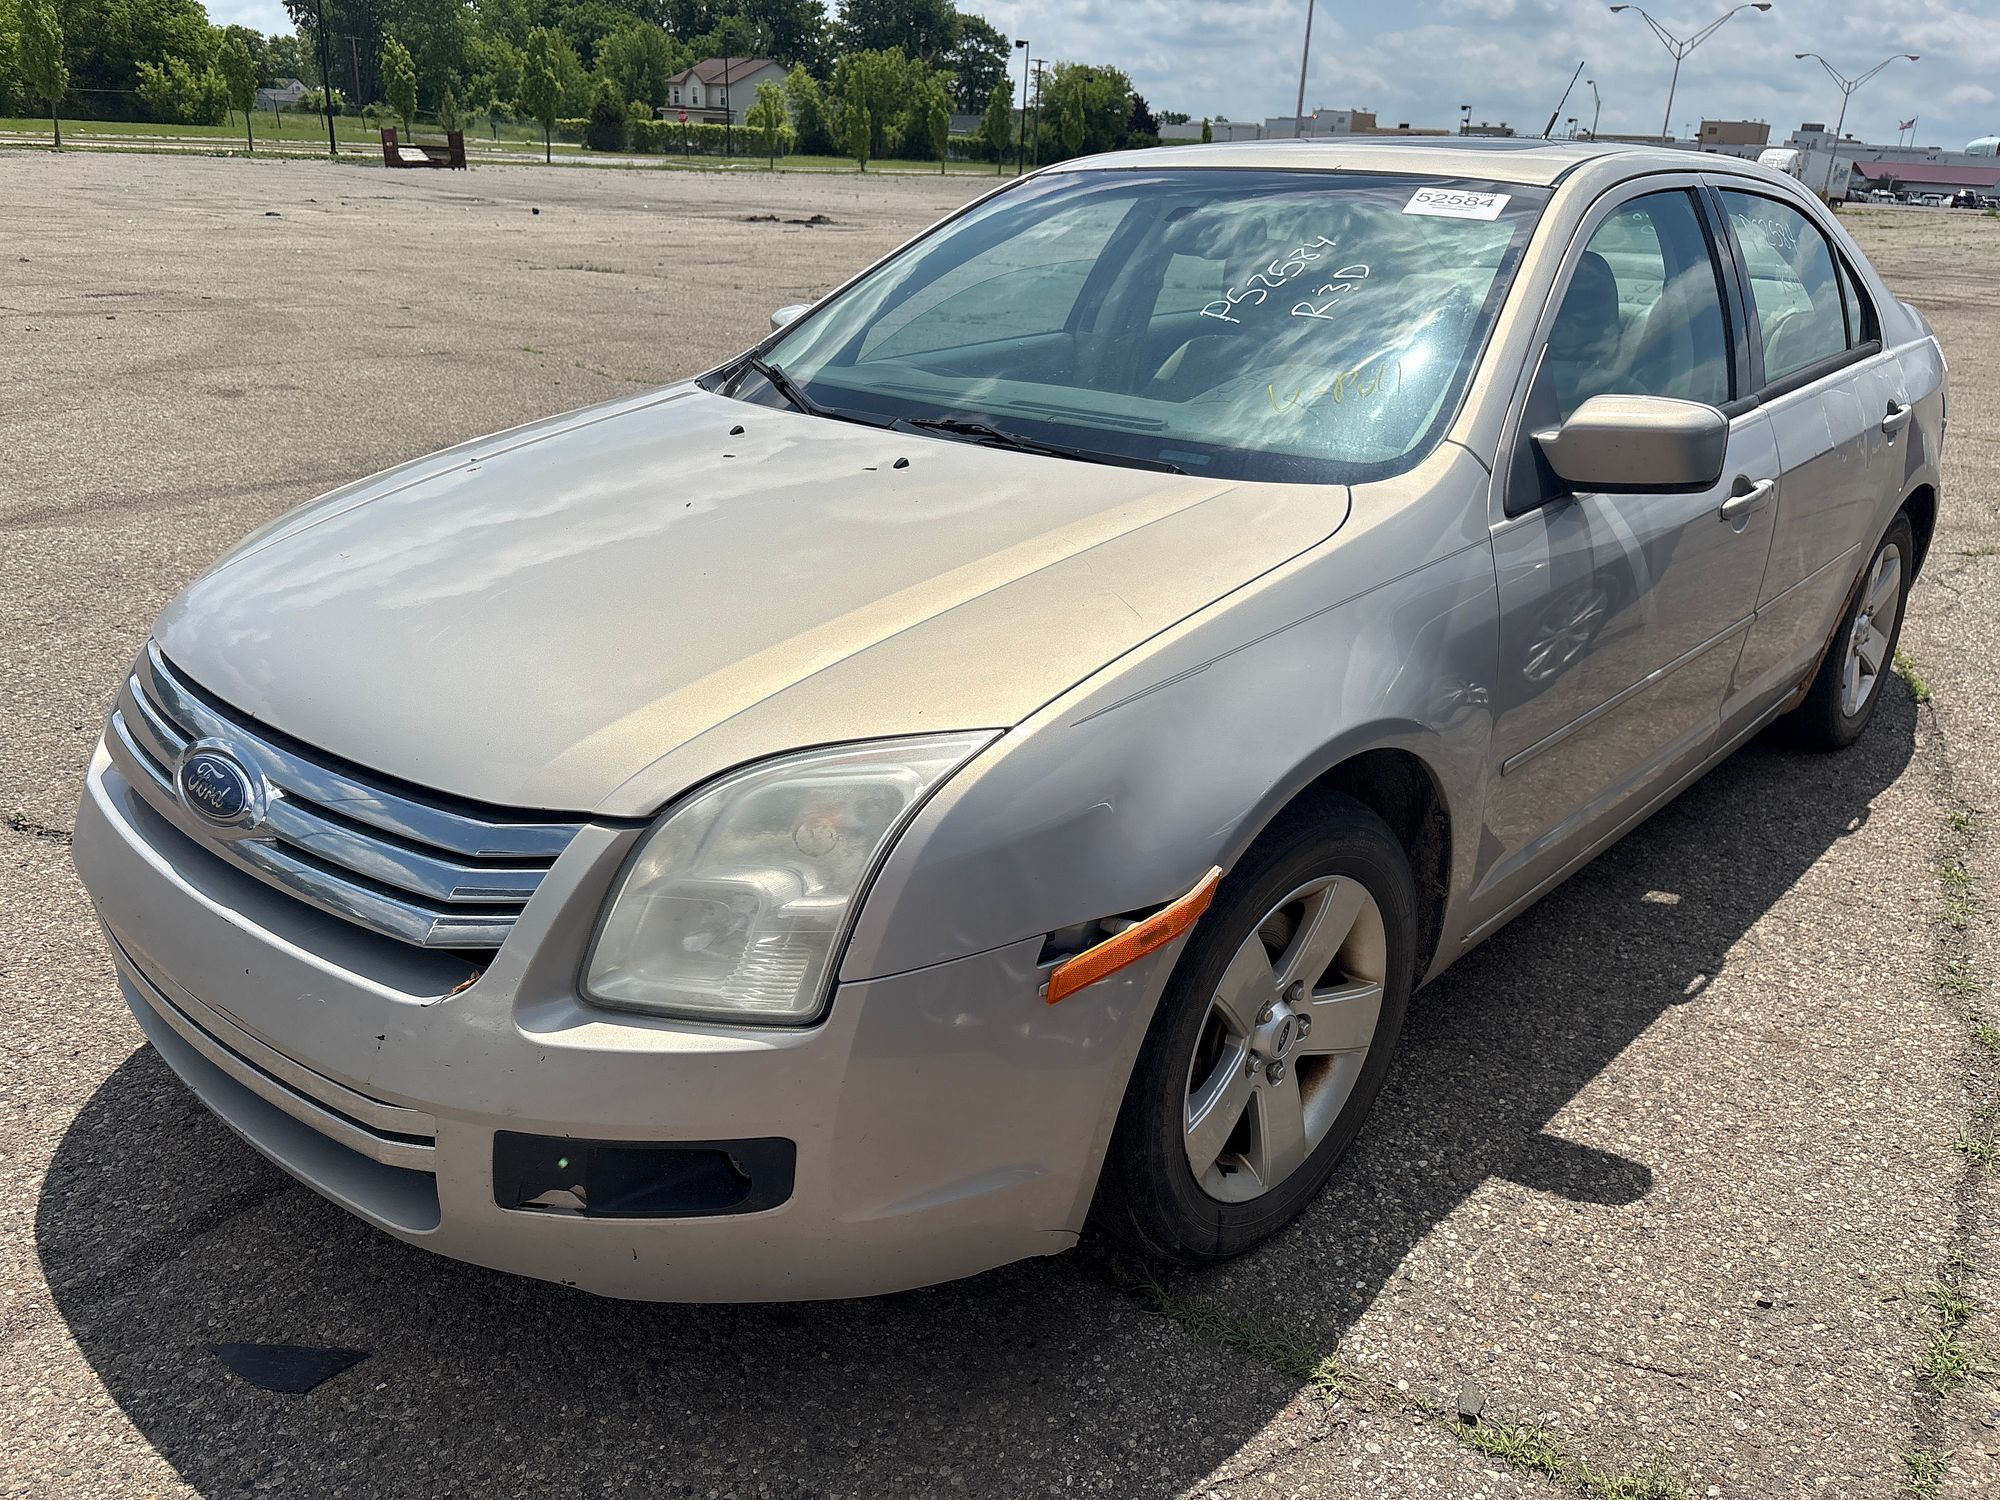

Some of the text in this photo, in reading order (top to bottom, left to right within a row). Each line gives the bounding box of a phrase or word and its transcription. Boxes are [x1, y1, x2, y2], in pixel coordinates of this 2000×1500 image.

[1416, 192, 1494, 208] 52584
[1200, 235, 1336, 324] P52584
[188, 762, 231, 808] Ford
